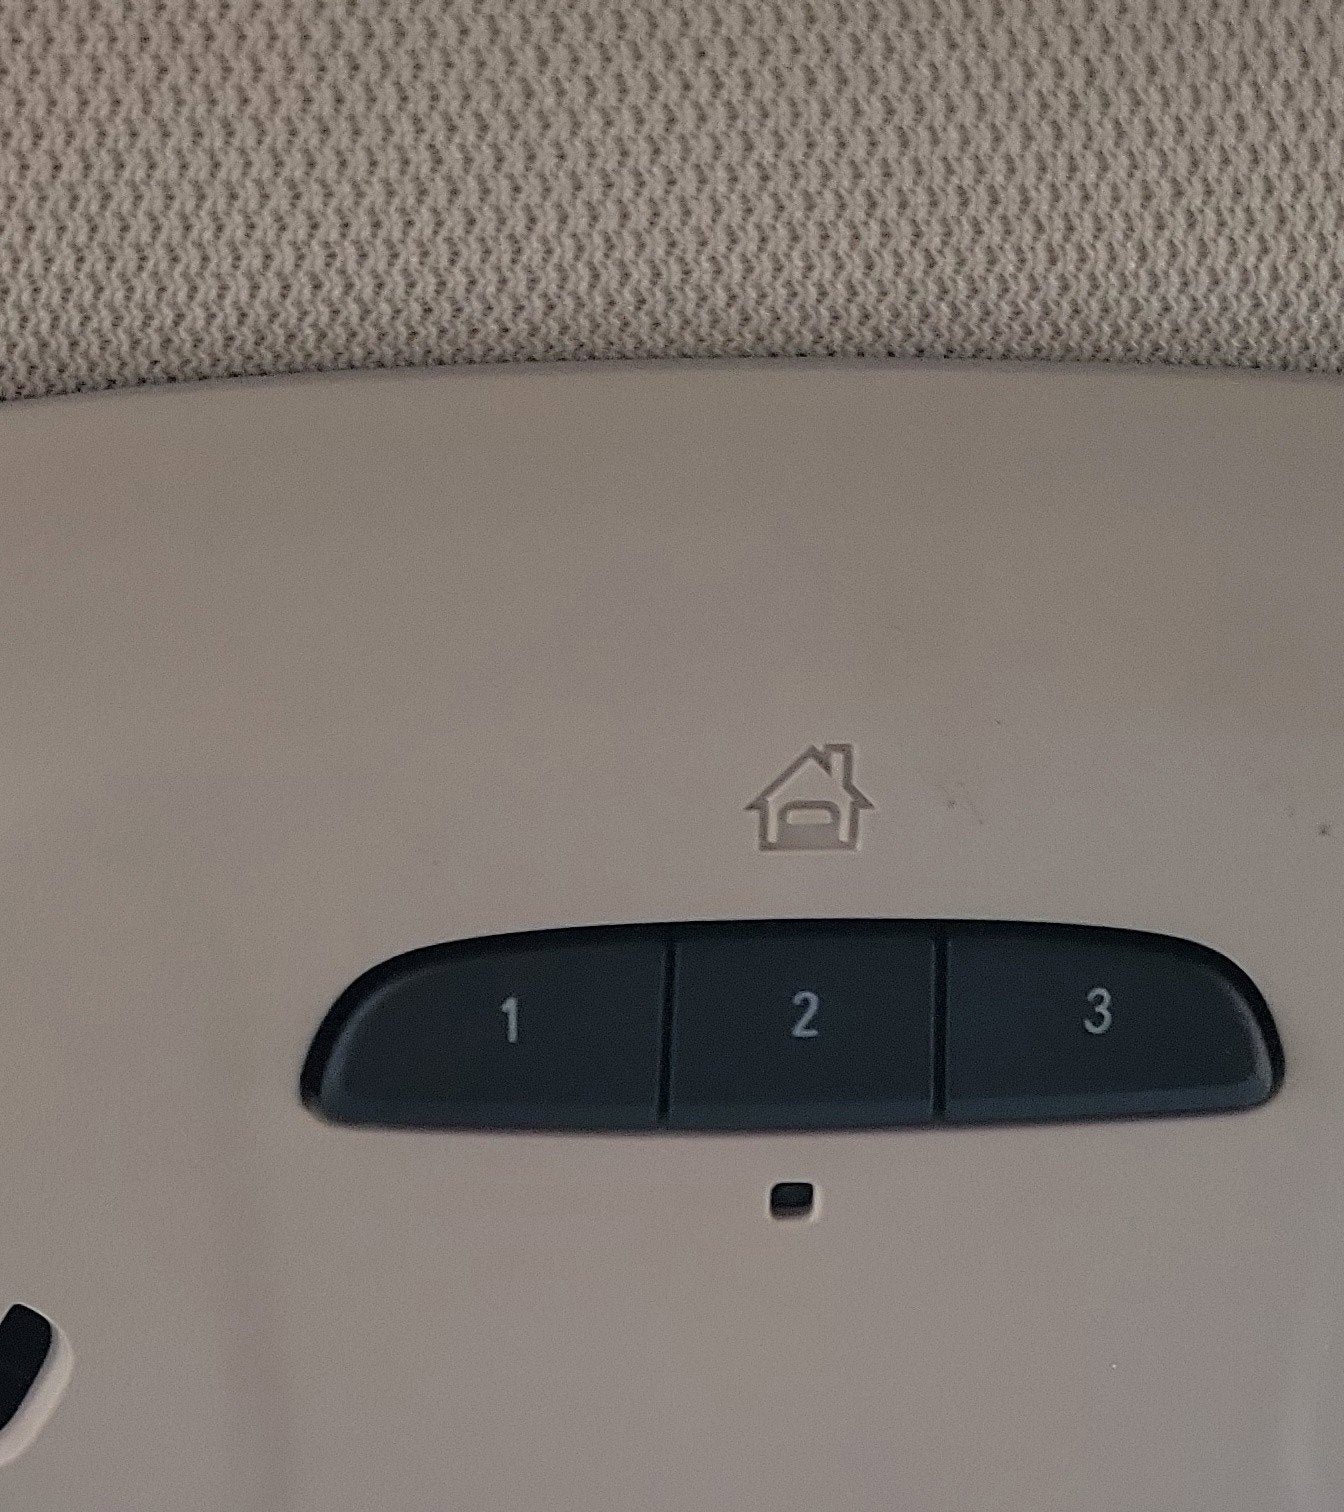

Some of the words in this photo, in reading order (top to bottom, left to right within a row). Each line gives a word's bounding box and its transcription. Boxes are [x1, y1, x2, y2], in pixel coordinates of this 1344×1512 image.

[500, 996, 519, 1043] 1
[791, 991, 820, 1037] 2
[1083, 987, 1113, 1034] 3
